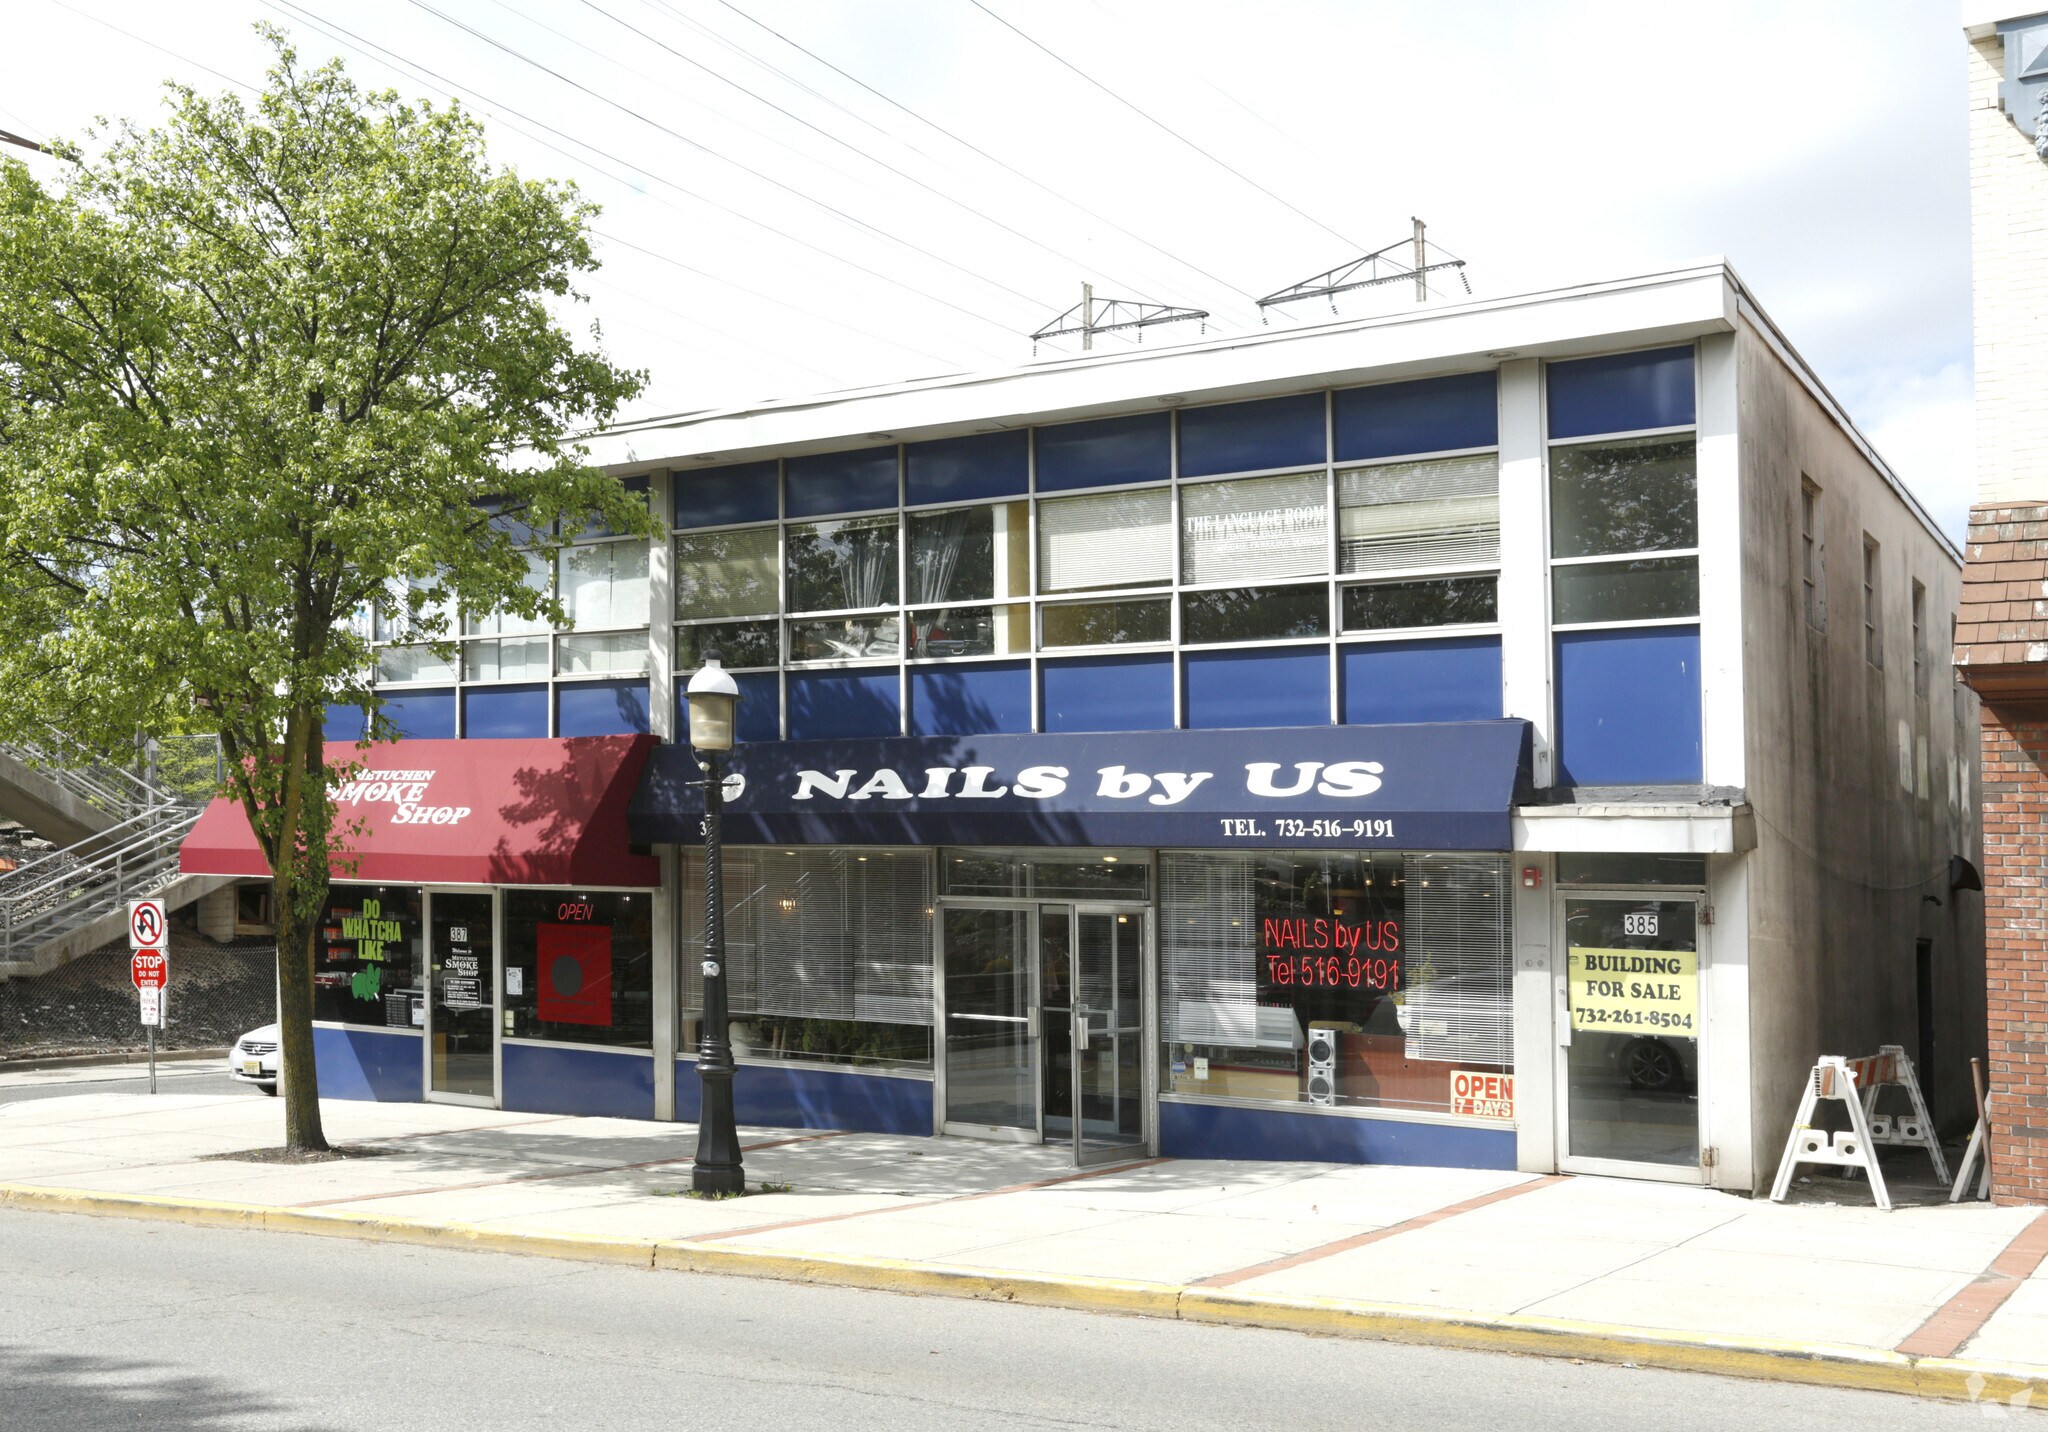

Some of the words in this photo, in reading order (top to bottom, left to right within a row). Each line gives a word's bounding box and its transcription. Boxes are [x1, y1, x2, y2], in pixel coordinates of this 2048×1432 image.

[1186, 516, 1212, 532] THE
[1215, 509, 1281, 528] LANGUAGE
[1285, 505, 1325, 524] ROOM
[792, 764, 1069, 801] NAILS
[1096, 765, 1213, 806] by
[1245, 761, 1384, 797] US
[391, 803, 471, 825] SHOP
[1221, 819, 1266, 837] TEL.
[1275, 818, 1395, 838] 732-516-9191
[363, 898, 380, 919] DO
[558, 903, 594, 920] OPEN
[342, 917, 402, 942] WHATCHA
[451, 928, 467, 941] 387
[1626, 915, 1657, 935] 385
[1264, 918, 1329, 949] NAILS
[1335, 919, 1361, 956] by
[1366, 920, 1399, 952] US
[358, 939, 384, 961] LIKE
[135, 956, 162, 969] STOP
[445, 959, 479, 970] SMOKE
[457, 968, 479, 977] SHOP
[1266, 955, 1295, 985] Tel
[1301, 956, 1399, 990] 516-9191
[1585, 954, 1682, 975] BUILDING
[138, 970, 147, 978] DO
[148, 970, 160, 978] NOT
[140, 979, 159, 987] ENTER
[1586, 980, 1625, 998] FOR
[1630, 982, 1682, 1001] SALE
[1576, 1007, 1692, 1029] 732-261-8504
[1455, 1074, 1513, 1100] OPEN
[1457, 1098, 1466, 1114] 7
[1473, 1099, 1512, 1116] DAYS
